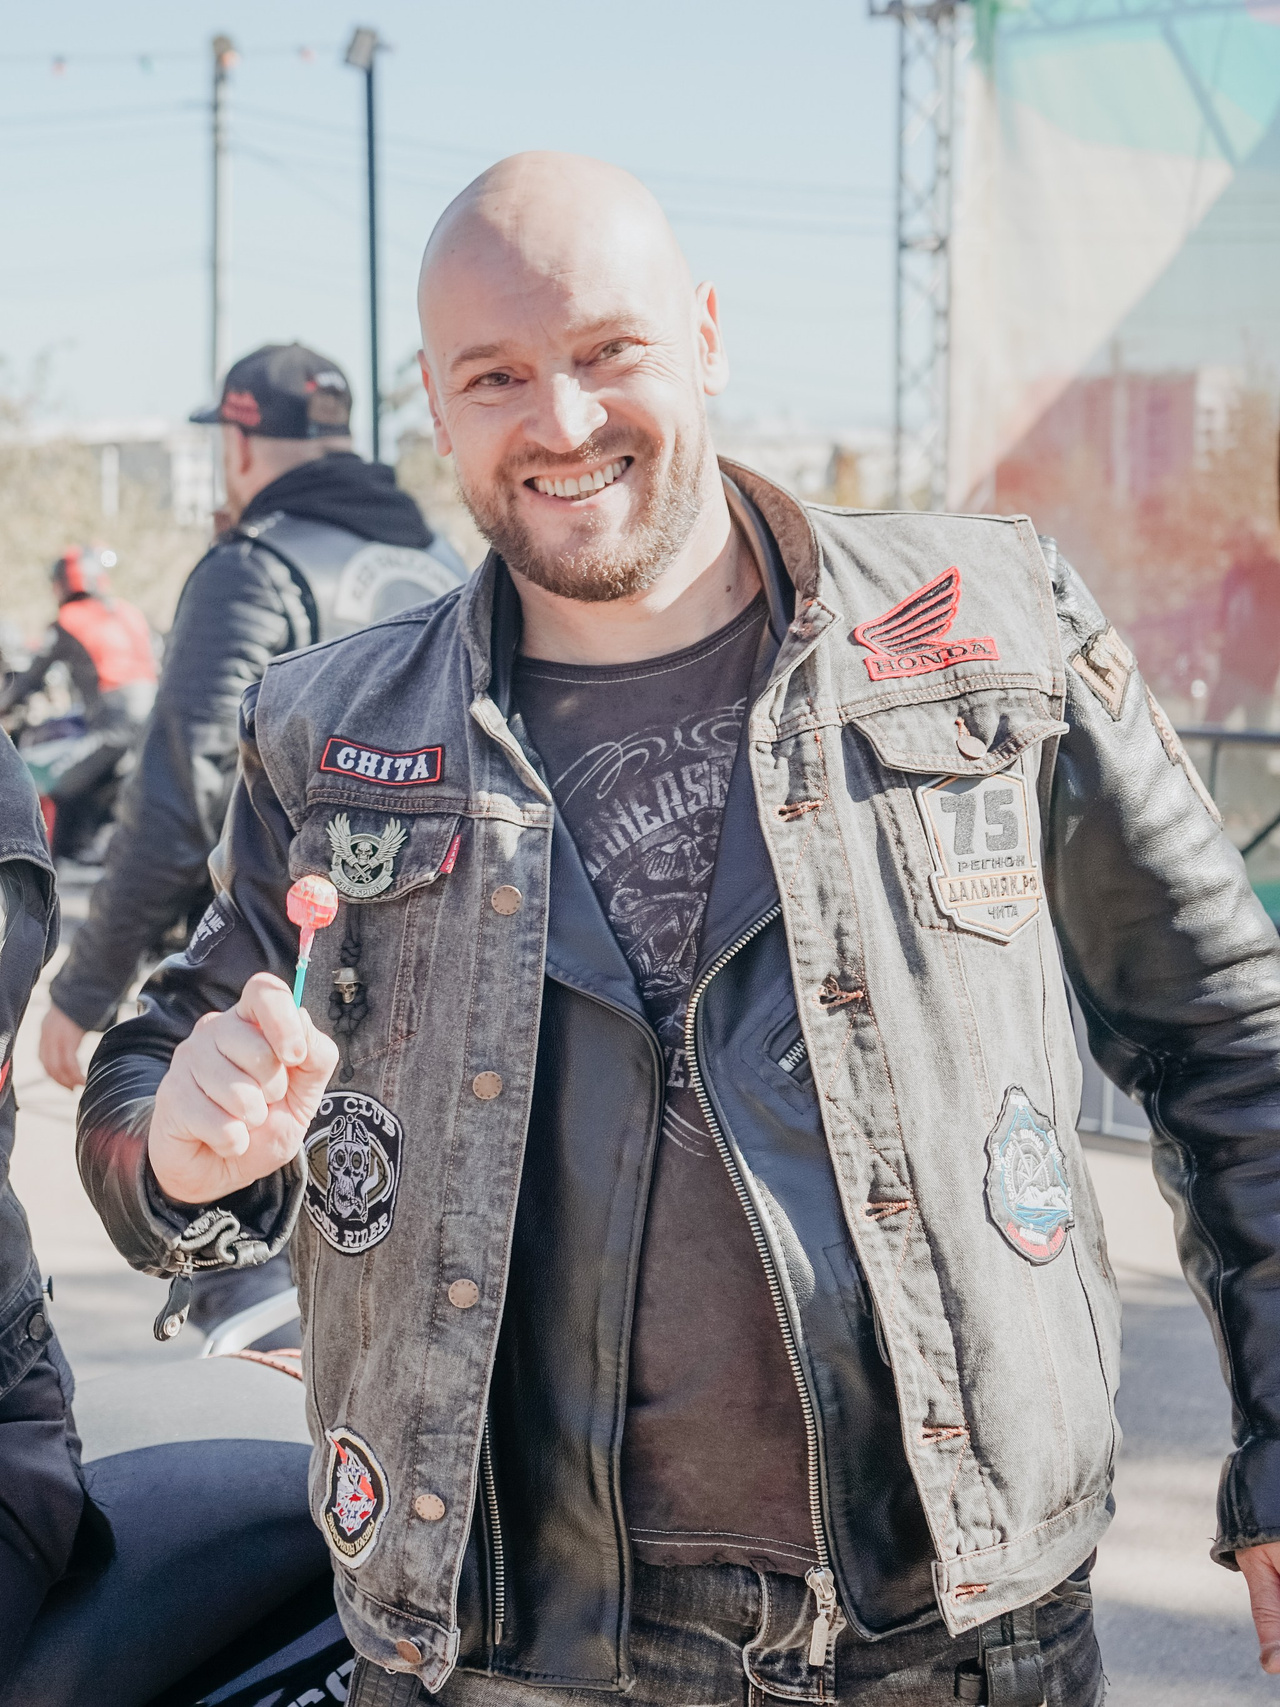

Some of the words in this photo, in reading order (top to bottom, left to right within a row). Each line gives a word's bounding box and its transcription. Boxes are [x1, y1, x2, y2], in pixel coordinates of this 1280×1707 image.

[872, 641, 993, 674] HONDA
[336, 746, 430, 782] CHITA
[939, 787, 1019, 857] 75
[957, 855, 1026, 873] РЕГИОН
[336, 878, 356, 896] FREE
[356, 882, 383, 898] SPIRIT
[948, 873, 1038, 903] ДАЛЬНЯК.РФ
[987, 904, 1020, 920] ЧИТА
[343, 1097, 396, 1137] CLUB
[305, 1193, 339, 1242] LONE
[342, 1213, 389, 1248] RIDER
